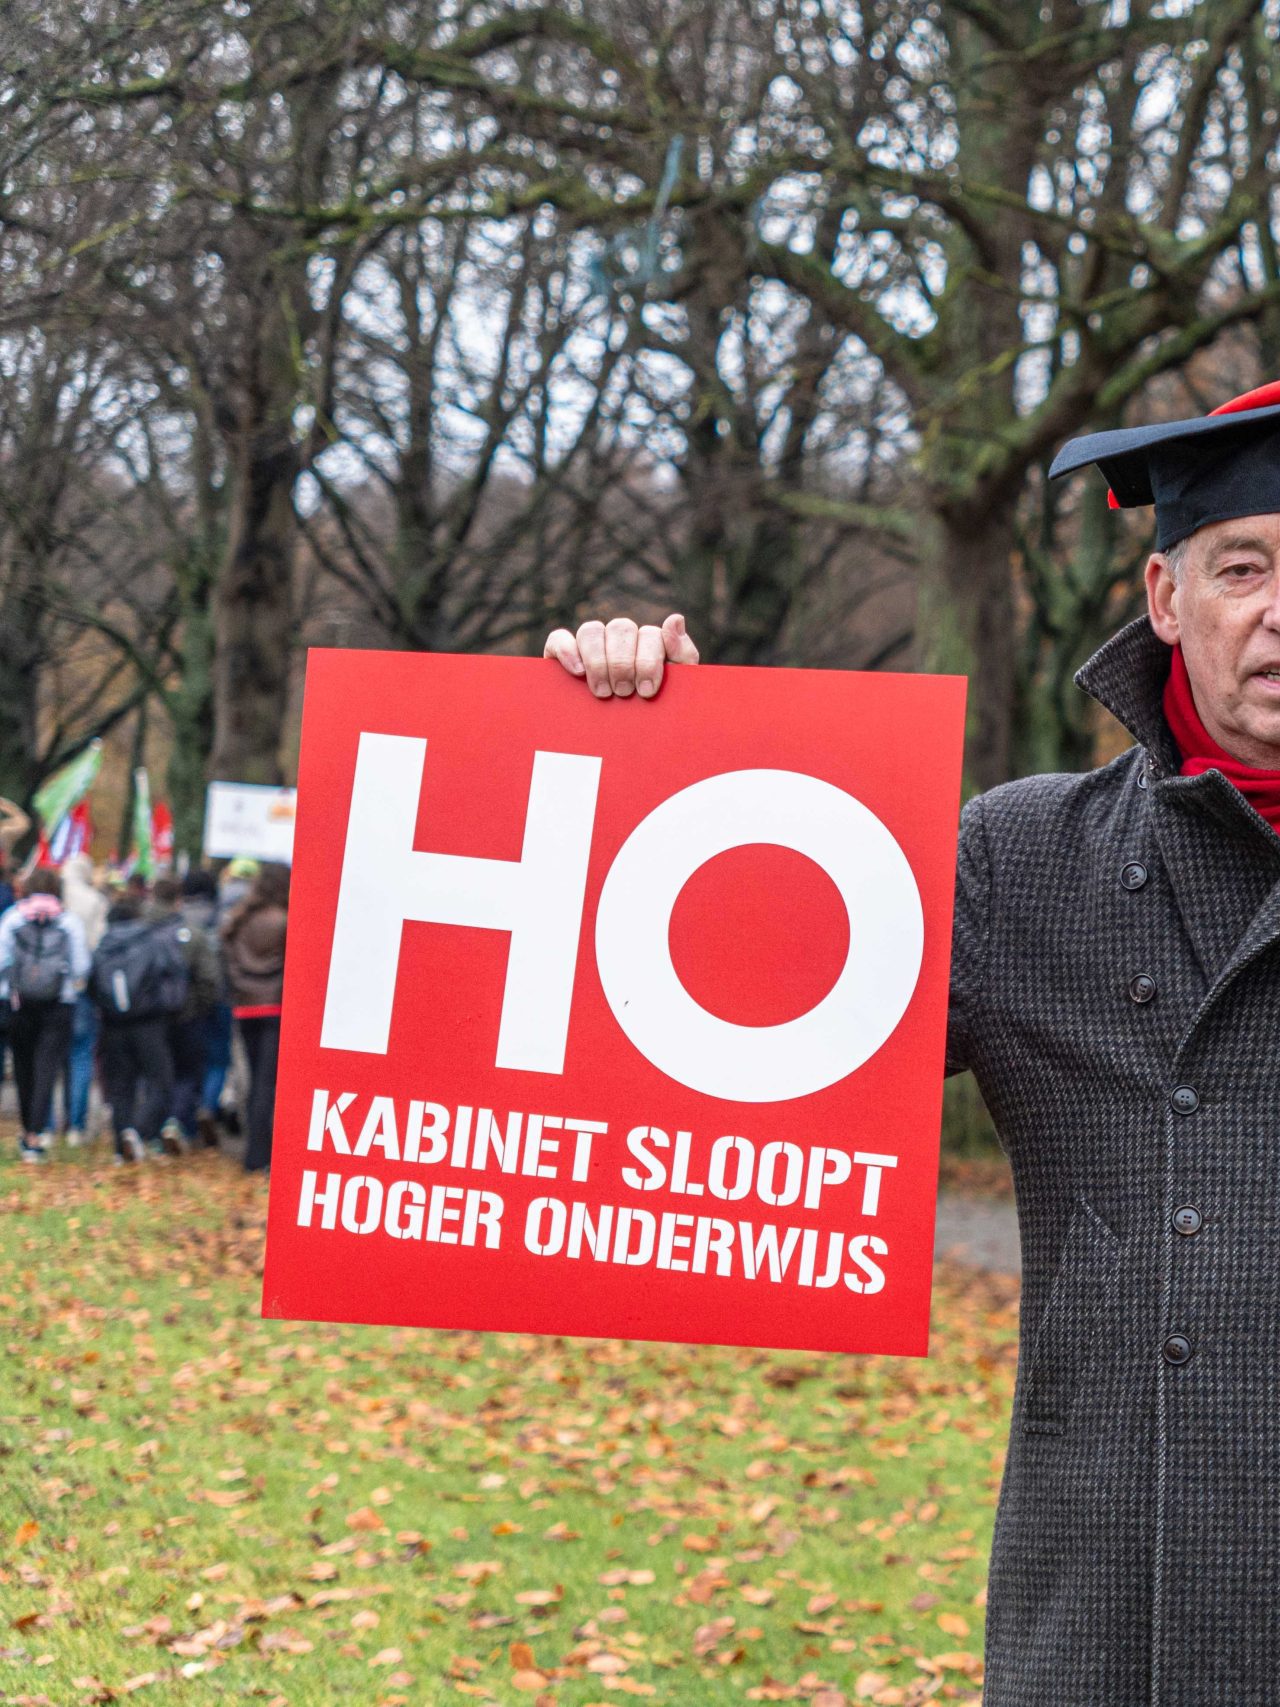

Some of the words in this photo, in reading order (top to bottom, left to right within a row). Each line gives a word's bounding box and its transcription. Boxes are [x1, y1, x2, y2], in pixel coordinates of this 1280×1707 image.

[320, 732, 924, 1102] HO
[307, 1089, 608, 1182] KABINET
[622, 1126, 898, 1216] SLOOPT
[297, 1170, 504, 1249] HOGER
[524, 1197, 888, 1294] ONDERWIJS
